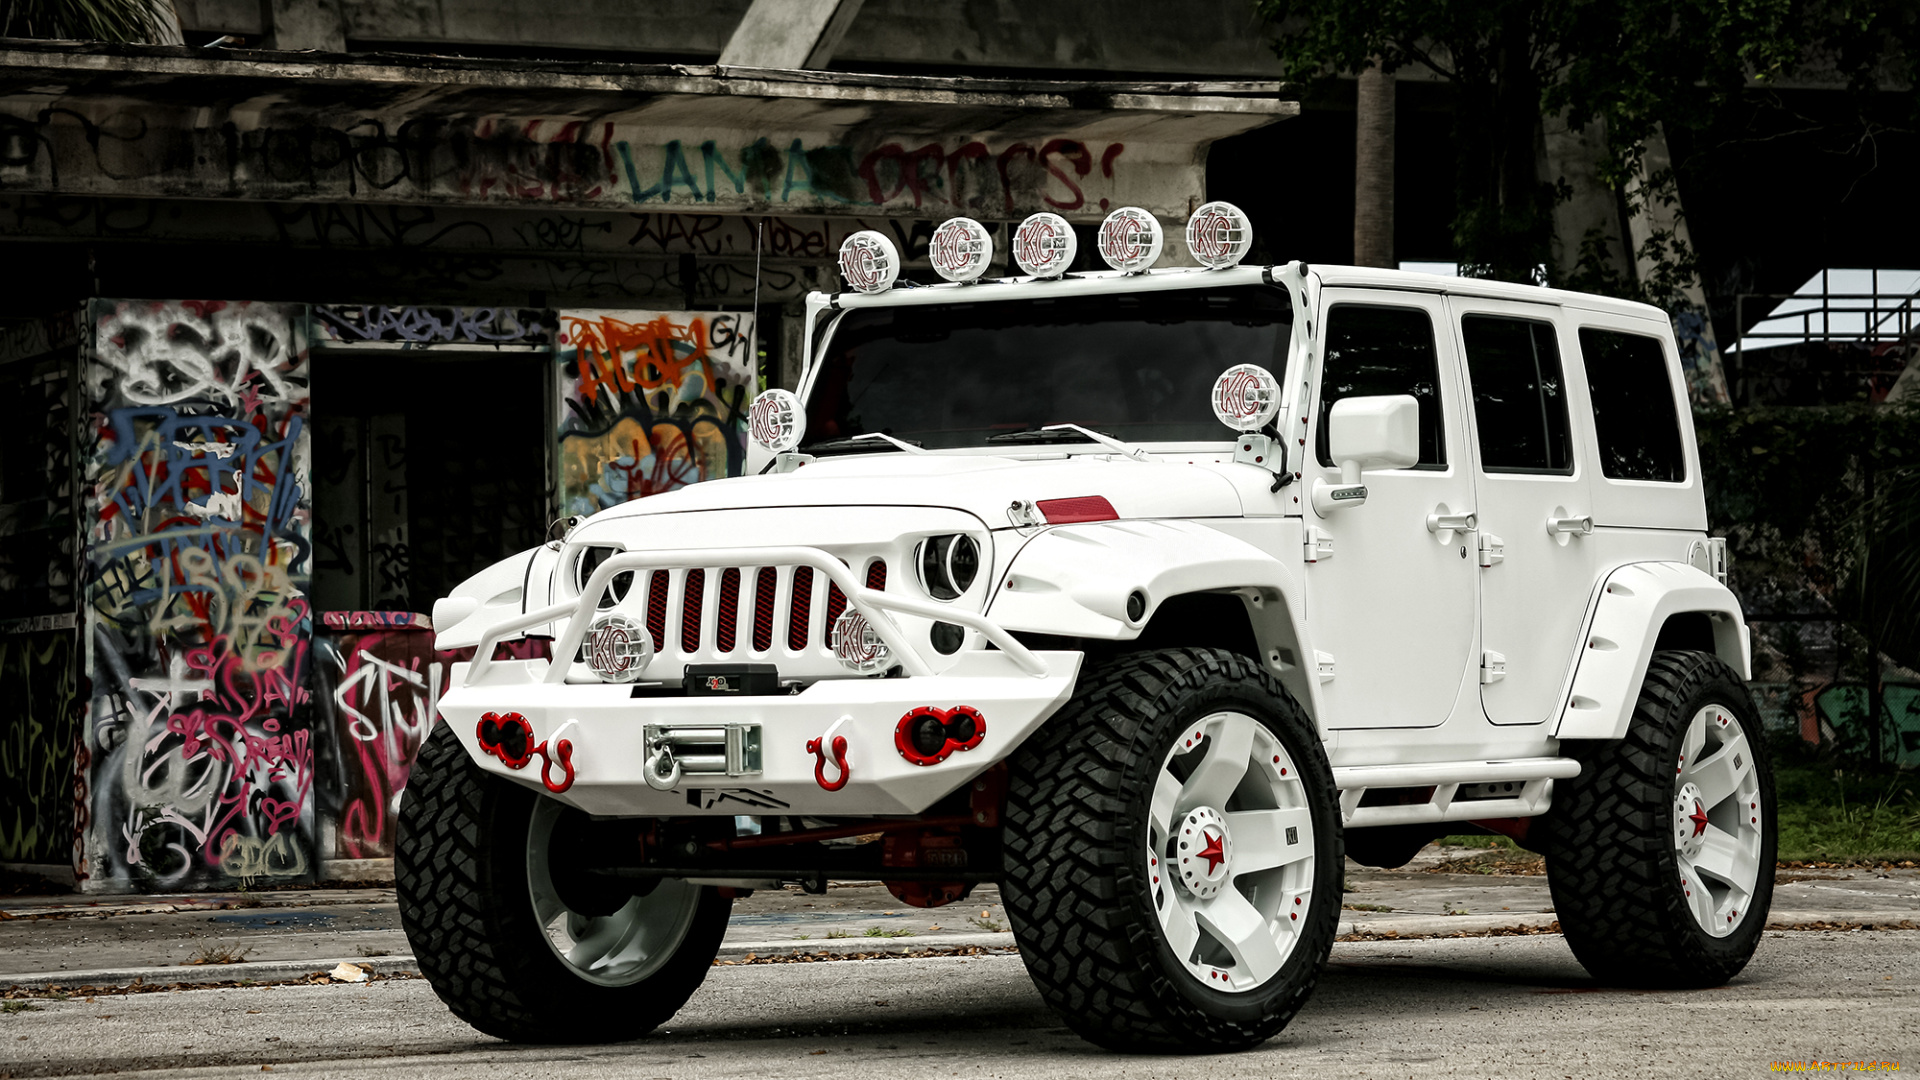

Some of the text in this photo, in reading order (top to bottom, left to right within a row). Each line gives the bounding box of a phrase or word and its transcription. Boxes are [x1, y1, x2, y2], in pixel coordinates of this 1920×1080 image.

[935, 225, 971, 271] KC
[1019, 221, 1056, 267] KC
[1105, 216, 1142, 262] KC
[1194, 212, 1232, 259] KC
[842, 245, 878, 289] KC
[1220, 371, 1261, 419] KC
[752, 398, 781, 445] KC
[590, 625, 630, 675] KC
[836, 612, 879, 665] KC
